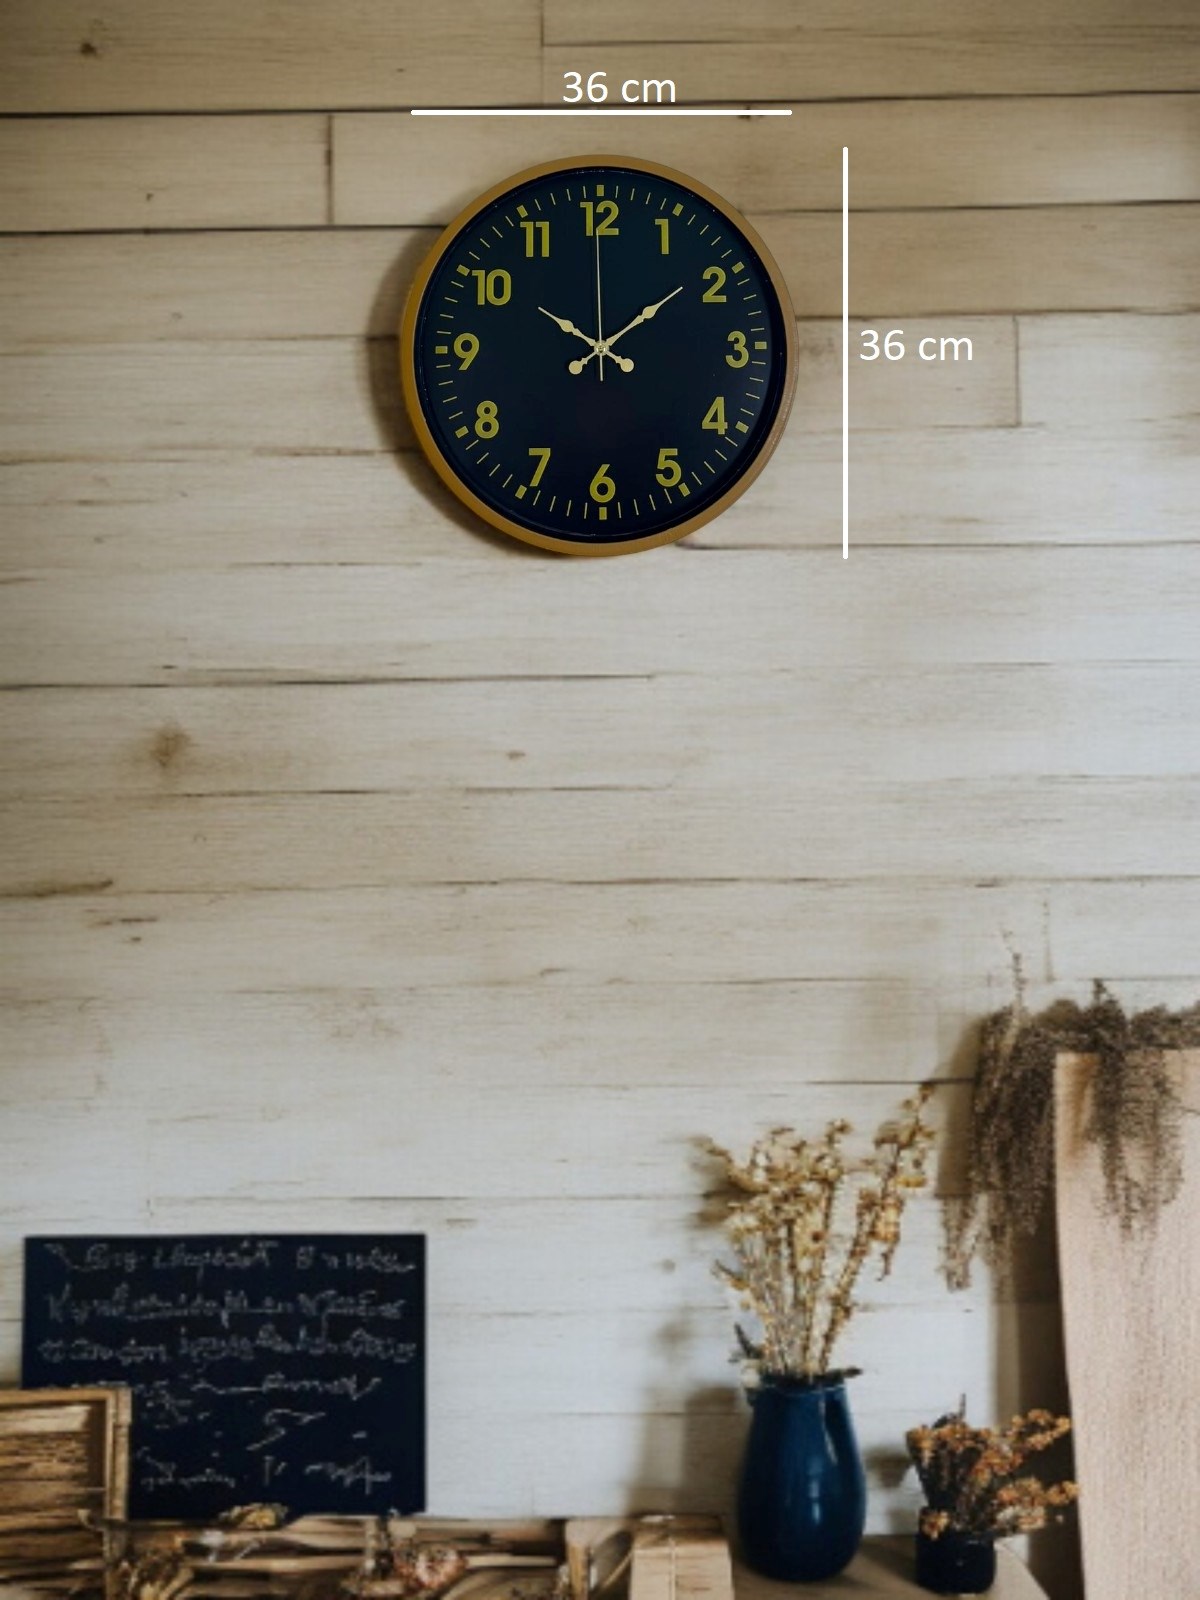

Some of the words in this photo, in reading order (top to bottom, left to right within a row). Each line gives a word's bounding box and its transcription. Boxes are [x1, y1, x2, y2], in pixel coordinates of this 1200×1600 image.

[580, 200, 620, 236] 12
[654, 218, 670, 255] 1
[520, 221, 550, 258] 11
[471, 268, 512, 306] 10
[702, 266, 727, 303] 2
[453, 333, 480, 371] 9
[725, 331, 750, 369] 3
[474, 400, 500, 439] 8
[701, 396, 729, 435] 4
[528, 447, 551, 487] 7
[589, 463, 616, 503] 6
[655, 448, 682, 488] 5
